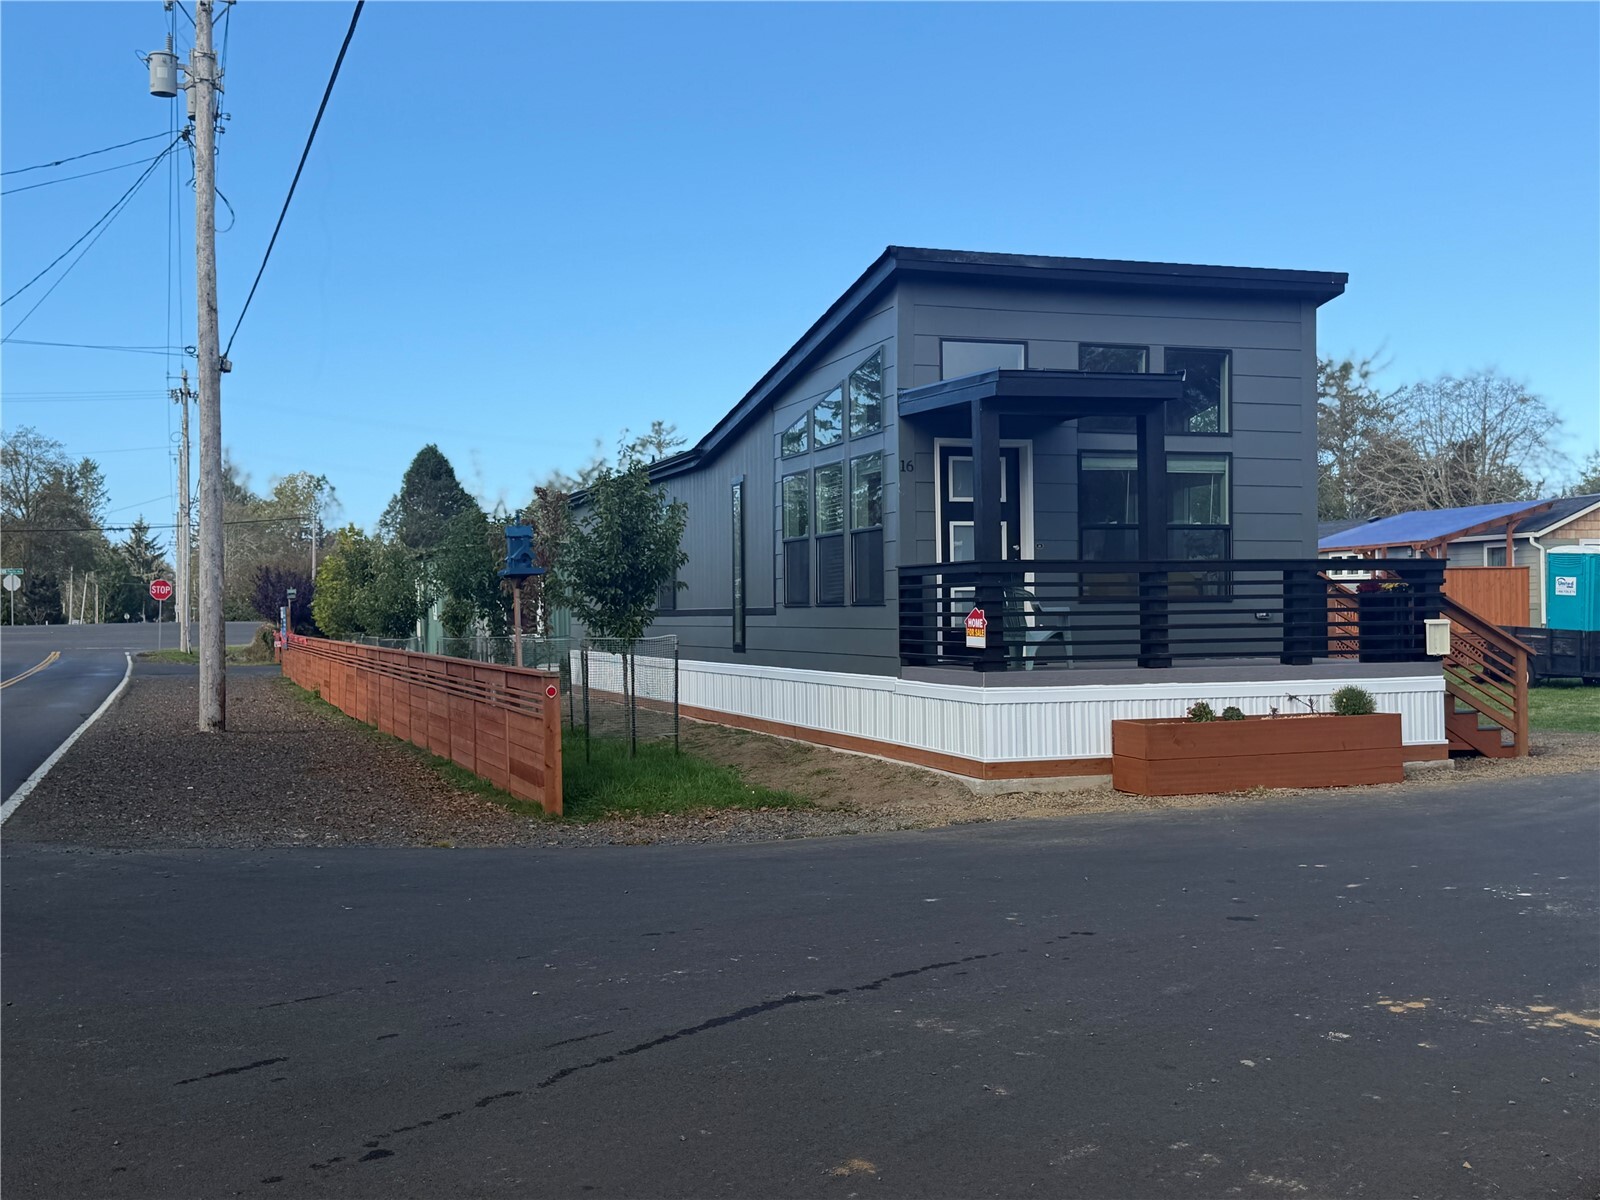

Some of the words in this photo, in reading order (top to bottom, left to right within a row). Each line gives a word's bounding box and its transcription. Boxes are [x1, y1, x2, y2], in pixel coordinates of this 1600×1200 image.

[900, 460, 914, 473] 16
[151, 585, 171, 594] STOP
[967, 618, 984, 628] HOME
[967, 628, 975, 637] FOR
[975, 628, 985, 637] SALE
